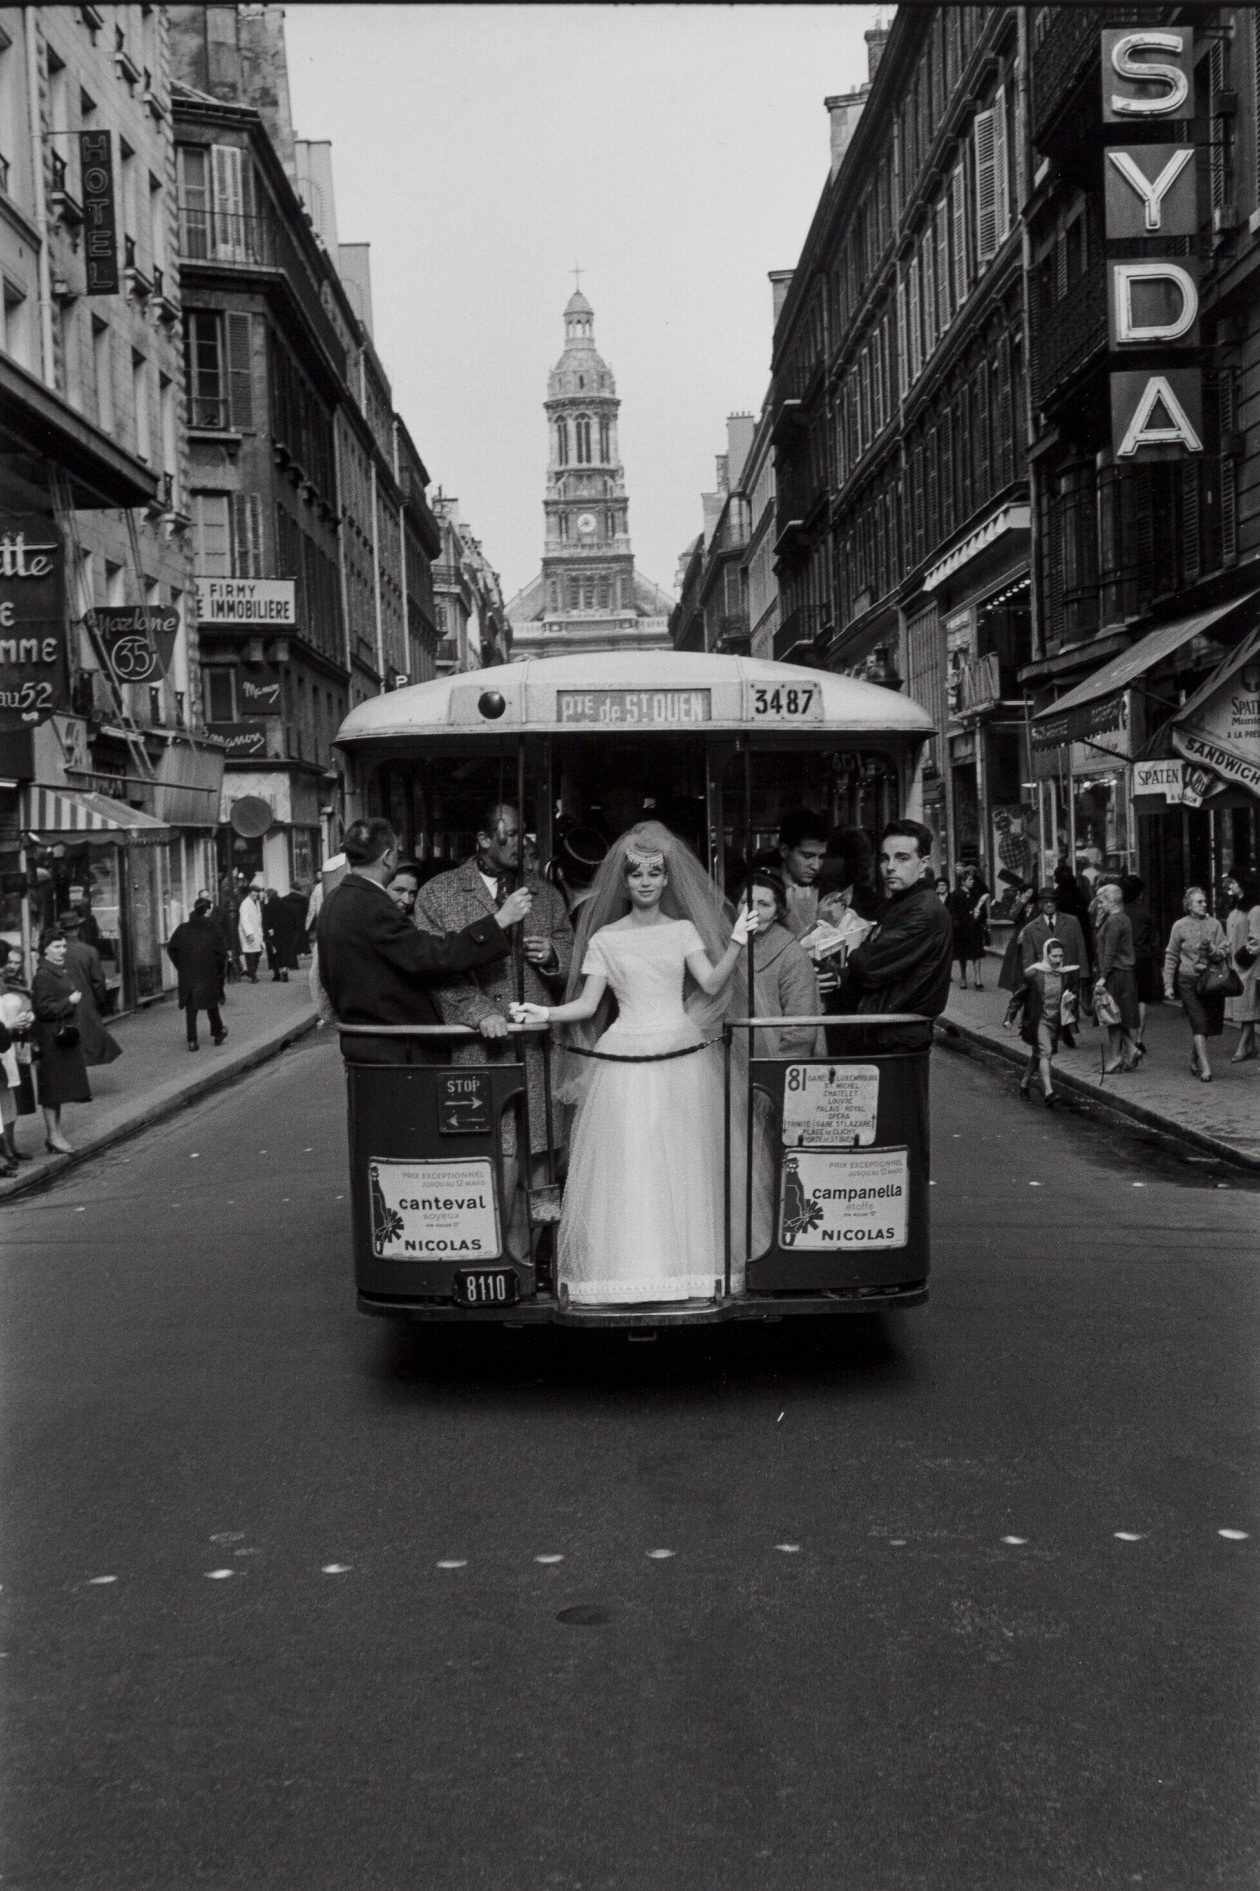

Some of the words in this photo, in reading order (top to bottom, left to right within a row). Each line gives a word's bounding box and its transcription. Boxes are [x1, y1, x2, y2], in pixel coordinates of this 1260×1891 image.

[81, 135, 114, 288] HOTEL
[1108, 32, 1203, 456] SYDA
[210, 584, 256, 598] FIRMY
[120, 642, 149, 672] 35
[21, 682, 53, 708] 52
[755, 689, 813, 714] 3487
[600, 697, 621, 722] de
[652, 692, 706, 722] OUEN
[1185, 738, 1260, 785] SANDWICH
[1138, 769, 1179, 785] SPATEN
[447, 1080, 481, 1093] STOP
[788, 1068, 807, 1091] 81
[850, 1159, 903, 1168] EXCEPTIONNEL
[422, 1171, 485, 1179] EXCEPTIONNEL
[399, 1195, 486, 1210] canteval
[812, 1184, 902, 1202] campanella
[822, 1228, 895, 1241] NICOLAS
[405, 1239, 482, 1251] NICOLAS
[467, 1275, 506, 1301] 8110
